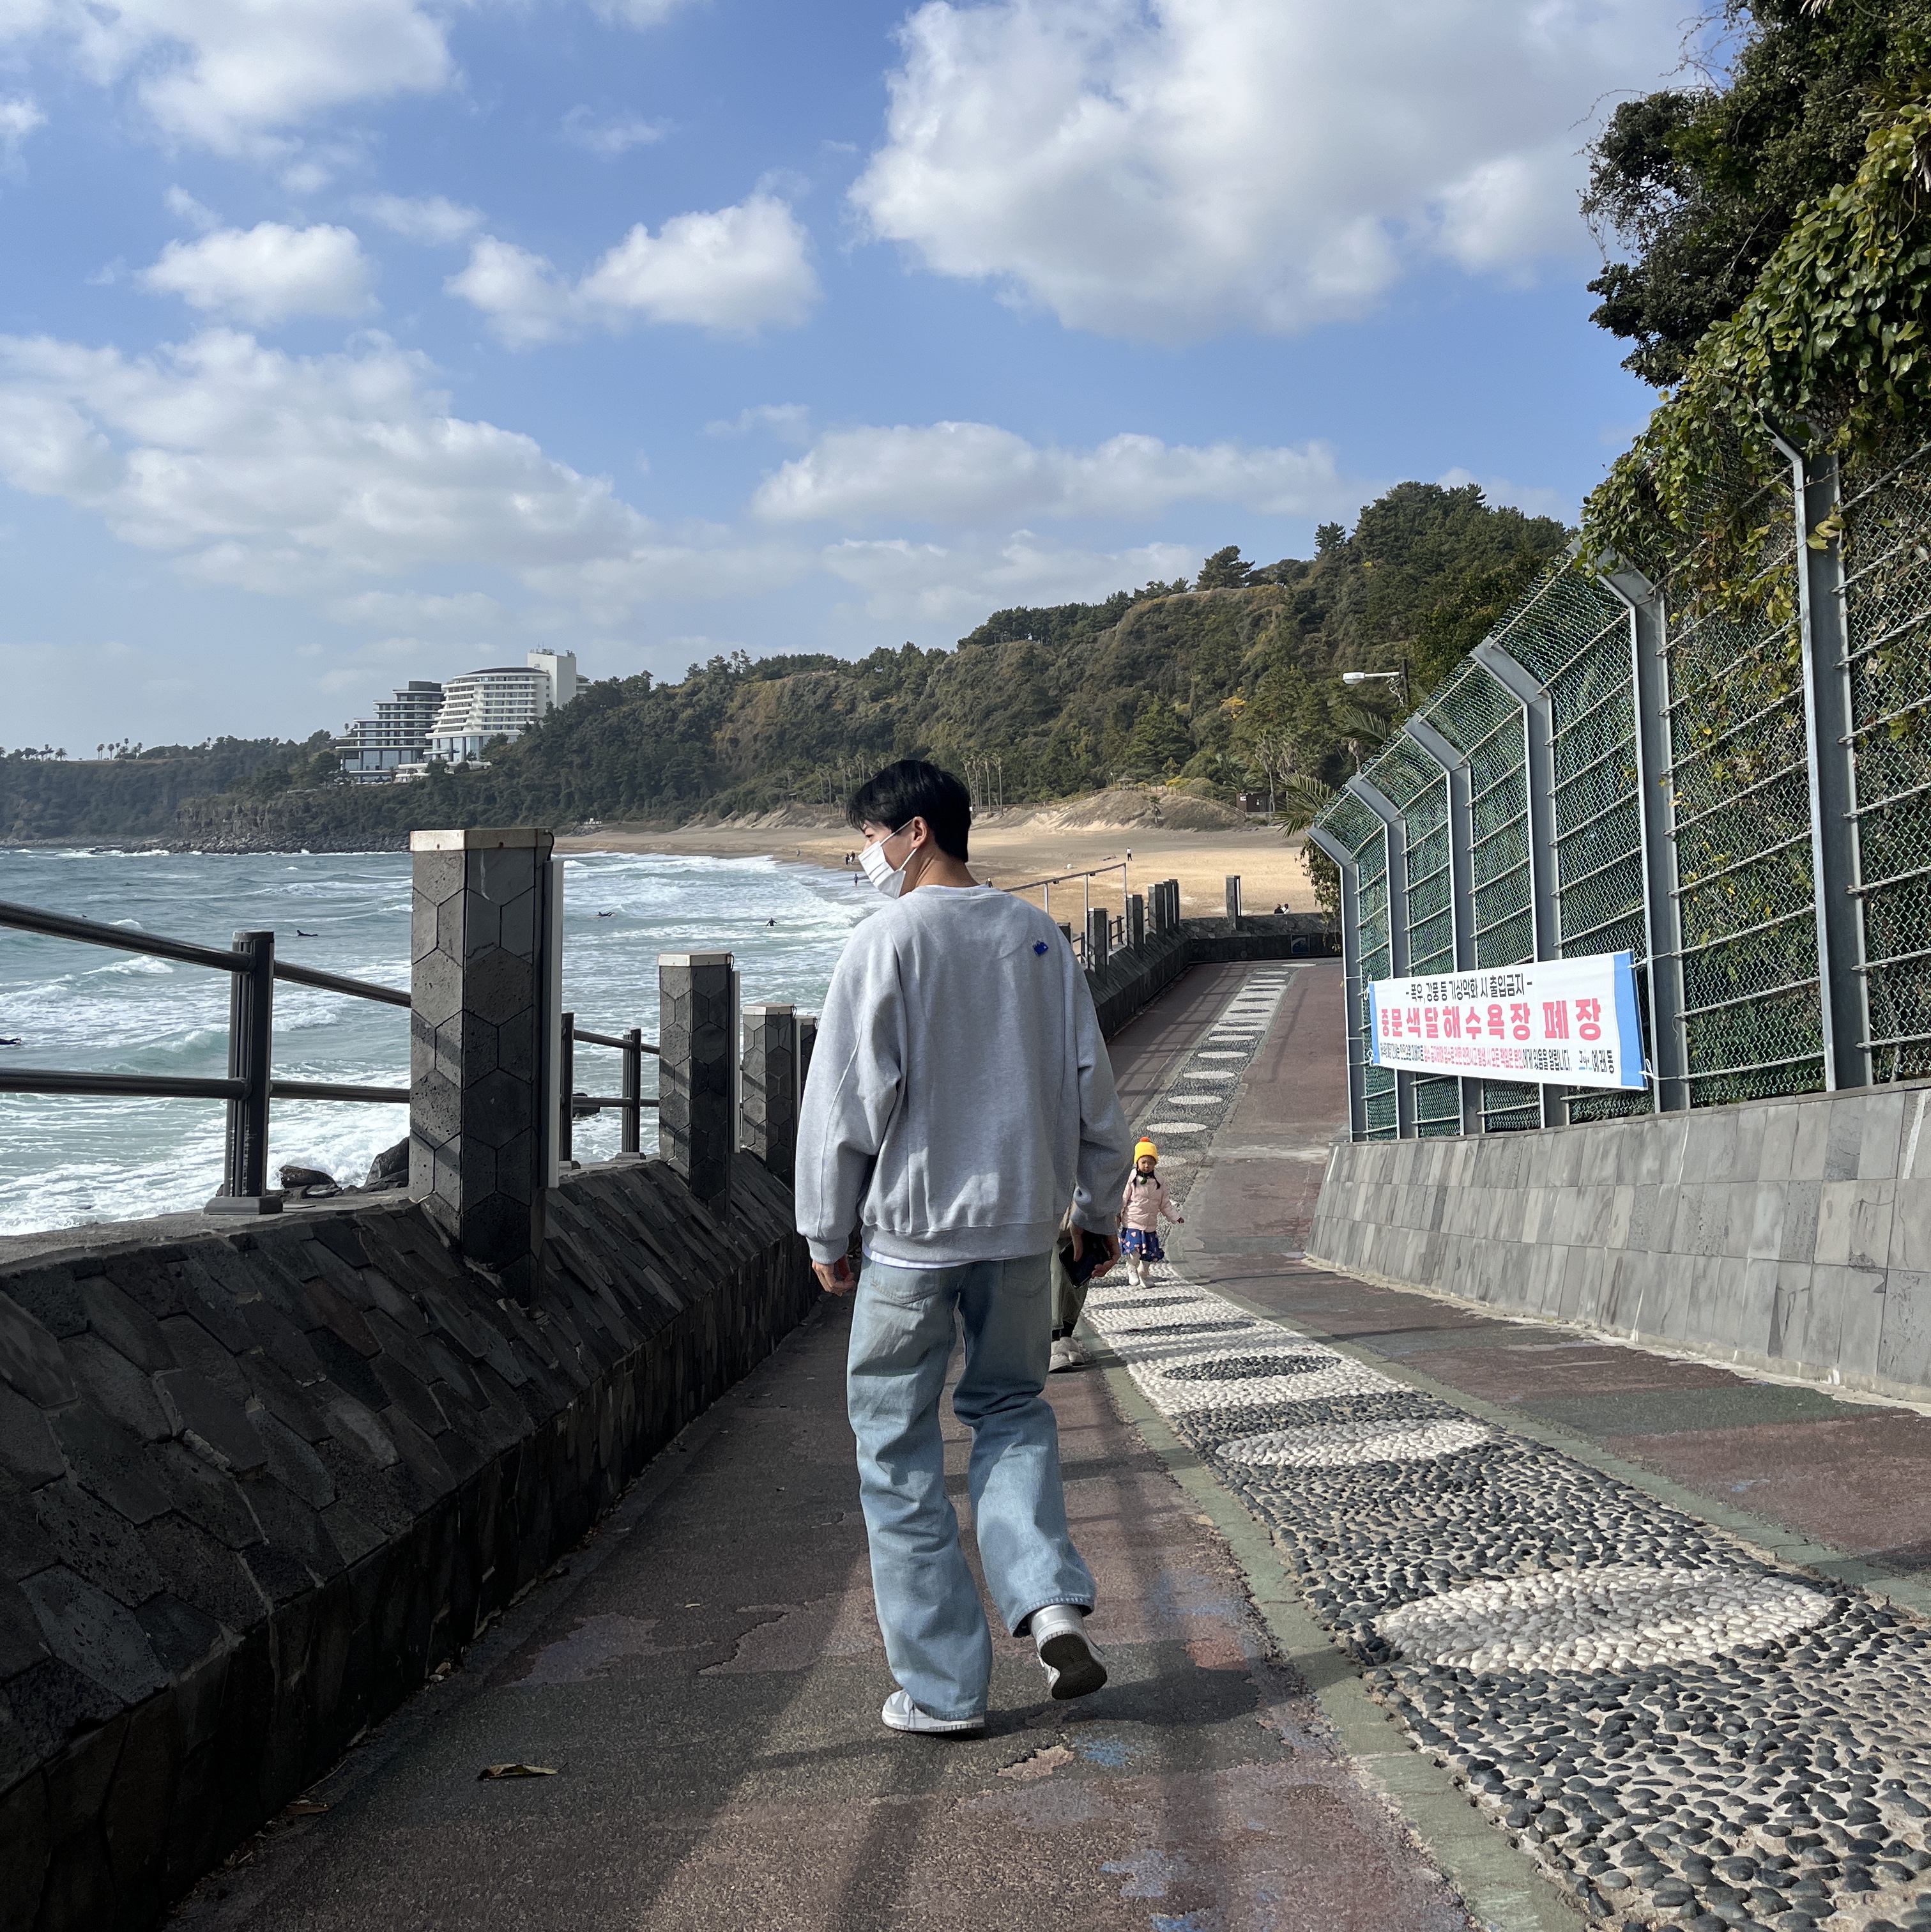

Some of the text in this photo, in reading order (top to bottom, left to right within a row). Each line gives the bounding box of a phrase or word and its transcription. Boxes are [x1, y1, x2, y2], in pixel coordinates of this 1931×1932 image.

[1410, 984, 1426, 1004] 폭우,
[1426, 982, 1439, 1002] 강풍
[1440, 981, 1447, 1001] 등
[1449, 977, 1478, 1000] 기상악화
[1481, 976, 1488, 998] 시
[1490, 973, 1525, 998] 출입금지
[1541, 998, 1601, 1041] 폐장
[1477, 1048, 1486, 1067] 발생
[1492, 1048, 1500, 1068] 모든
[1500, 1048, 1514, 1069] 책임은
[1514, 1048, 1533, 1070] 본인에게
[1533, 1048, 1548, 1070] 있음을
[1548, 1048, 1572, 1071] 알립니다.
[1591, 1050, 1615, 1074] 예래동
